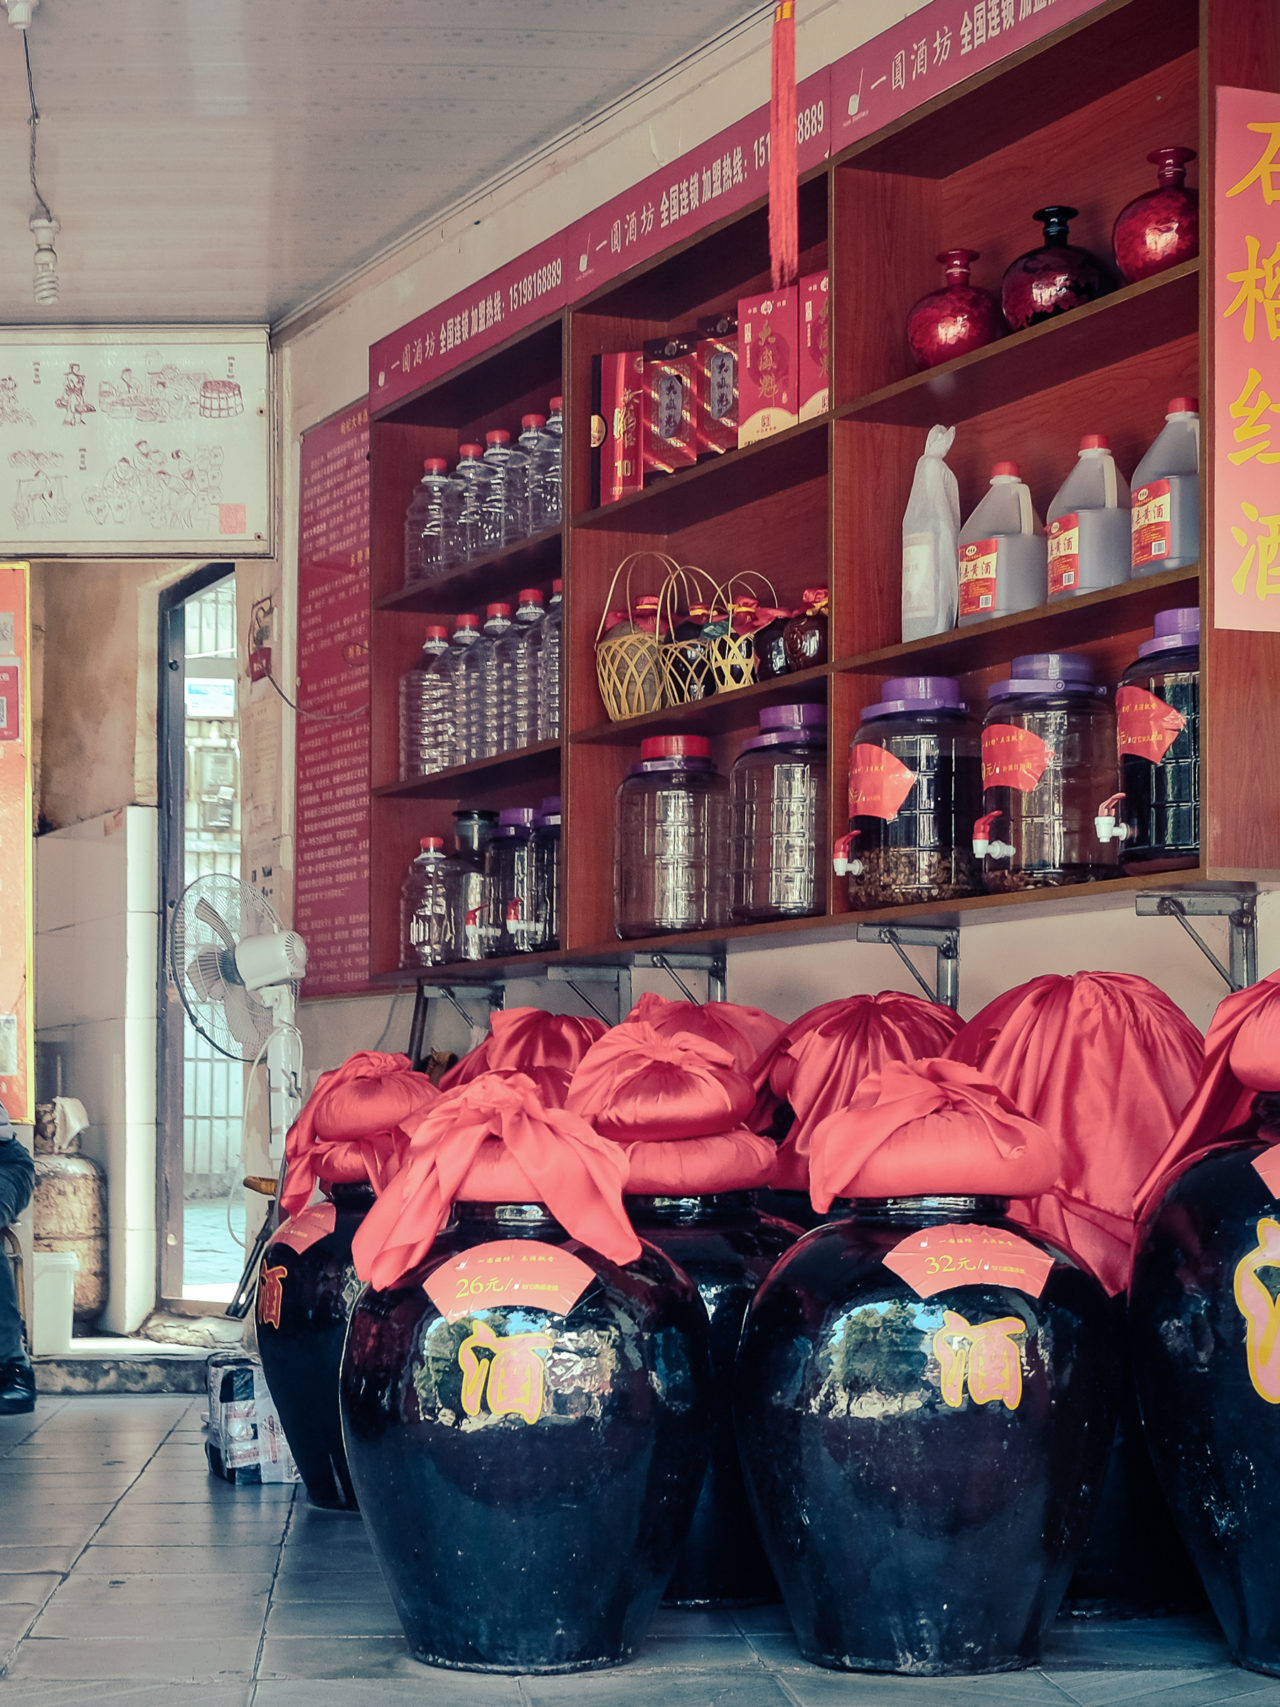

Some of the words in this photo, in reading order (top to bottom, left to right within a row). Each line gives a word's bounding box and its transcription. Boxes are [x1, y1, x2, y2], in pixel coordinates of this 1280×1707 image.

[660, 171, 699, 228] 全国连锁
[439, 308, 469, 355] 全国连锁
[509, 257, 562, 312] 15198168889
[458, 1319, 555, 1425] 酒
[933, 1310, 1027, 1411] 酒
